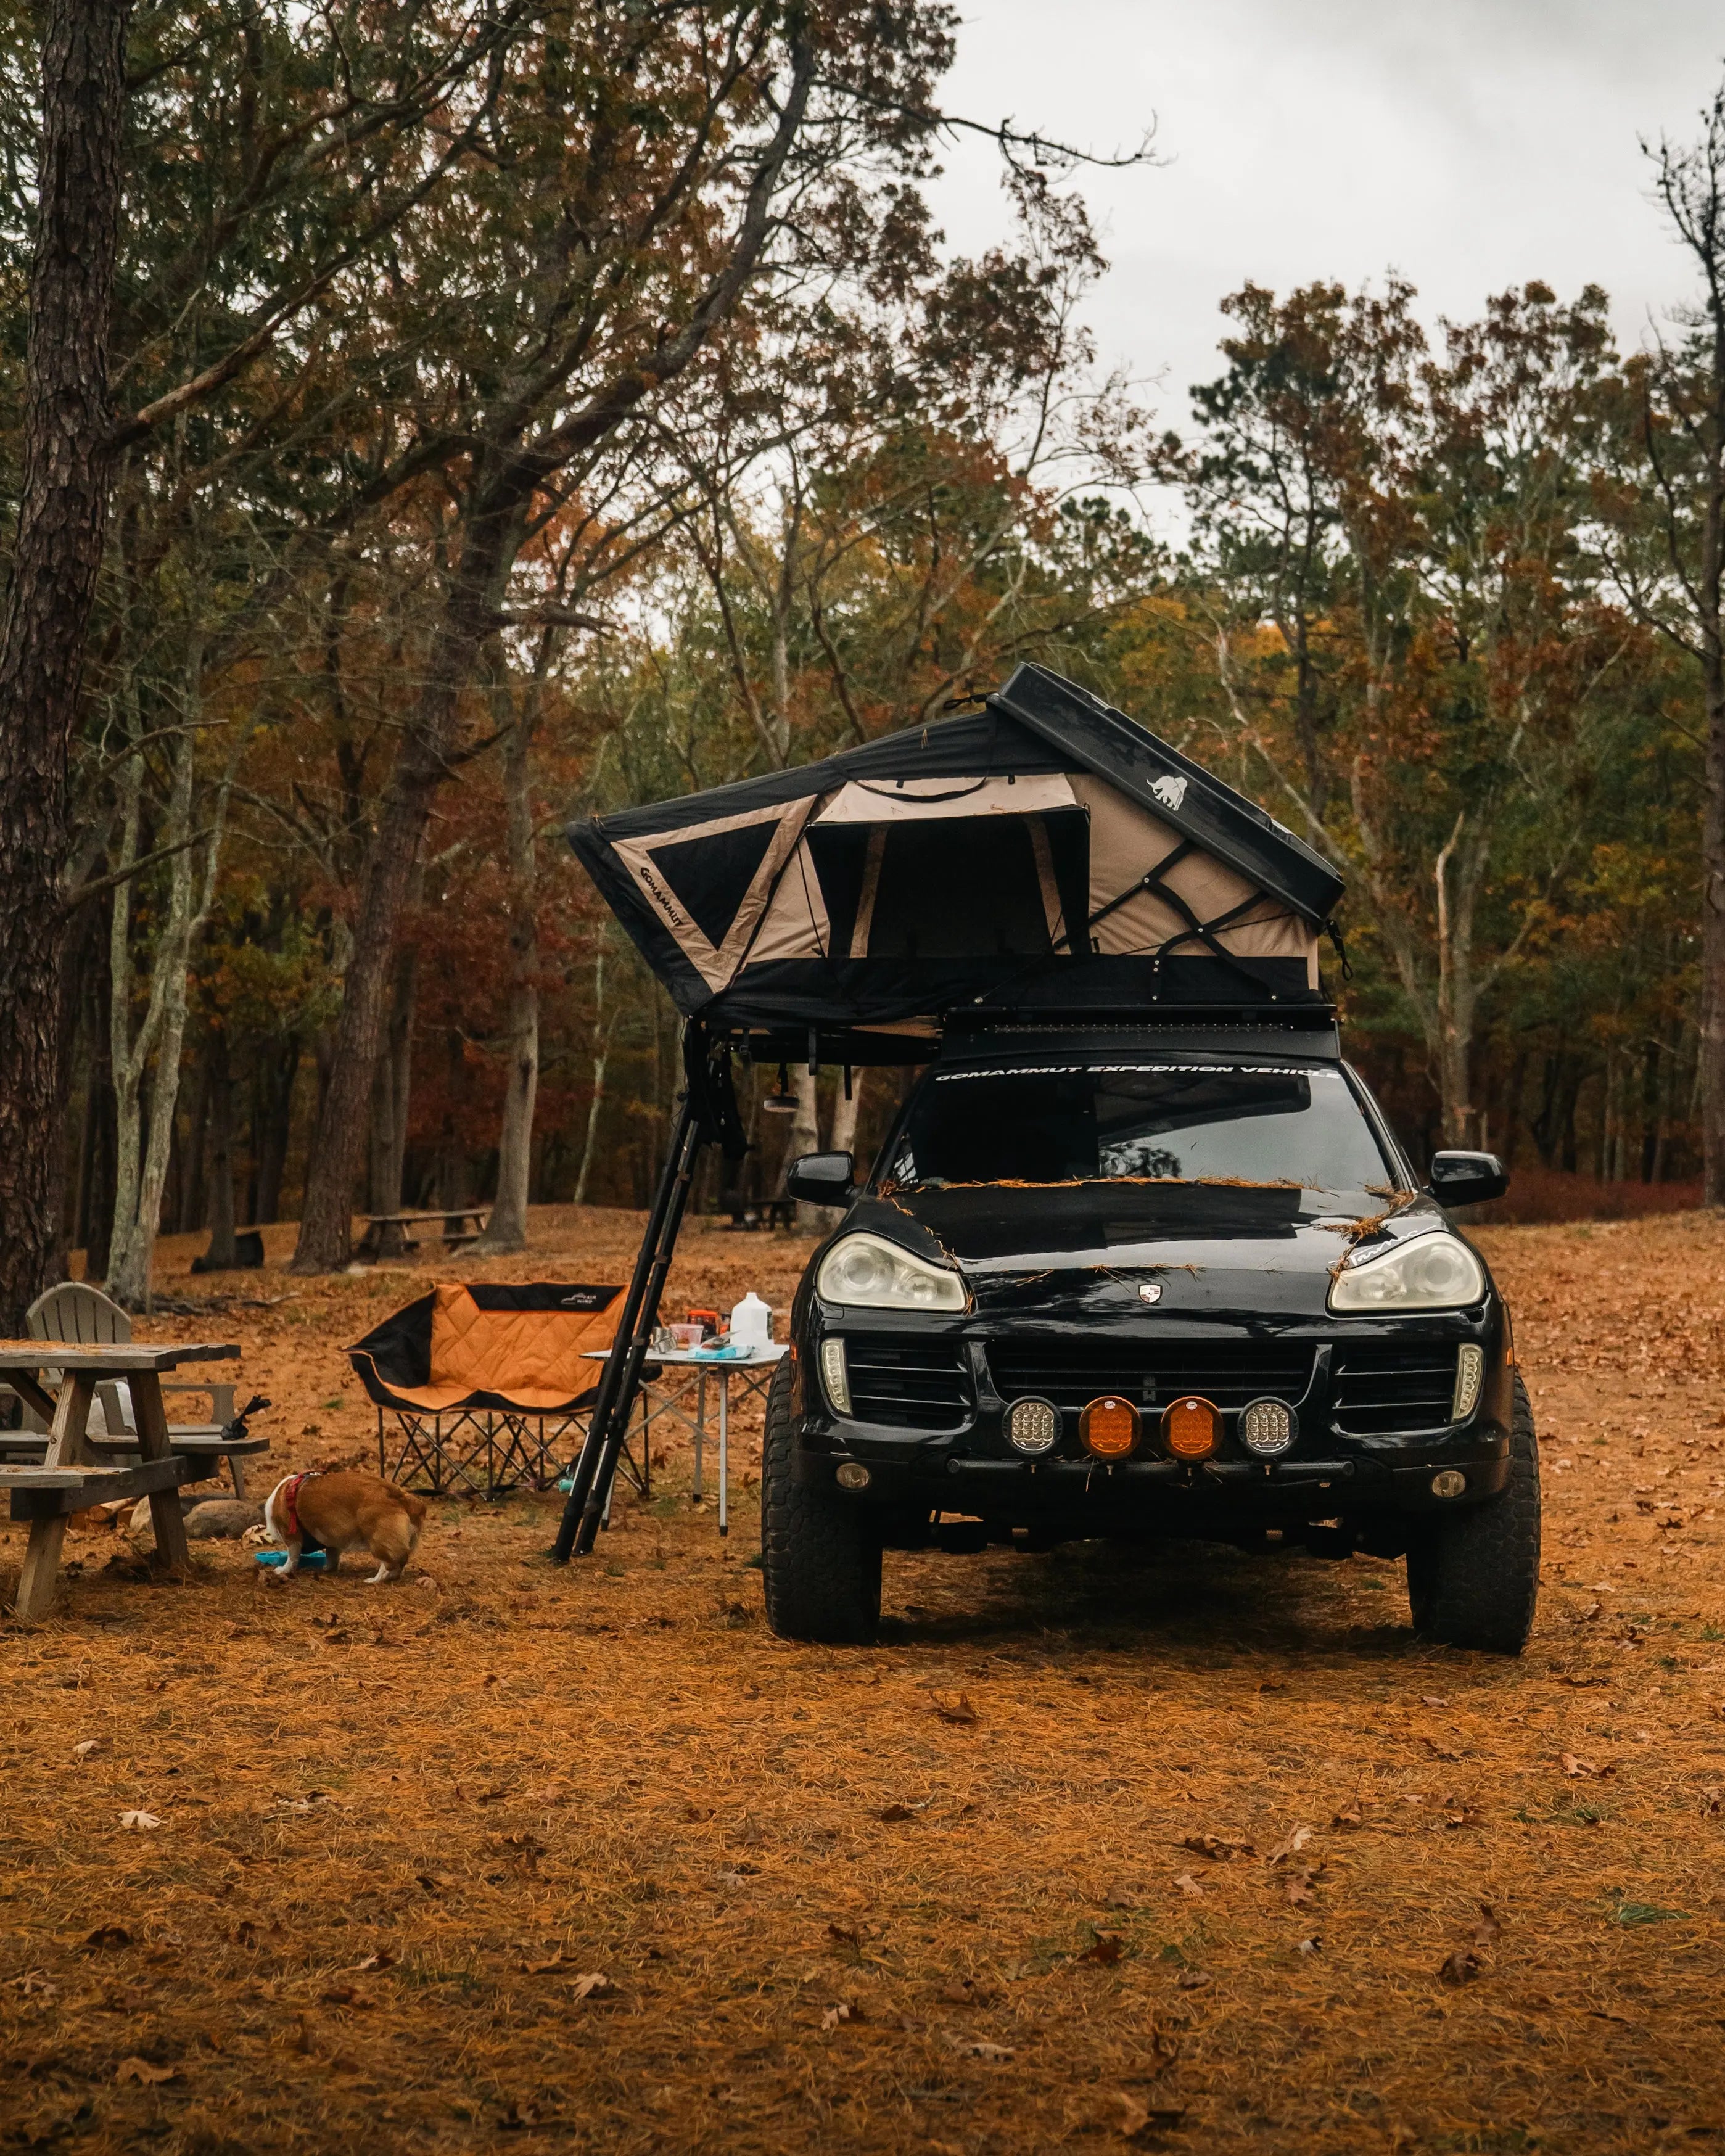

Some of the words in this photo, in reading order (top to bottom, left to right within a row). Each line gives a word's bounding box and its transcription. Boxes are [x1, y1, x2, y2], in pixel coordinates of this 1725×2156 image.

[640, 867, 683, 927] GOMAMMUT
[935, 1067, 1082, 1081] GOMAMMUT
[1240, 1066, 1342, 1079] VEHICLE
